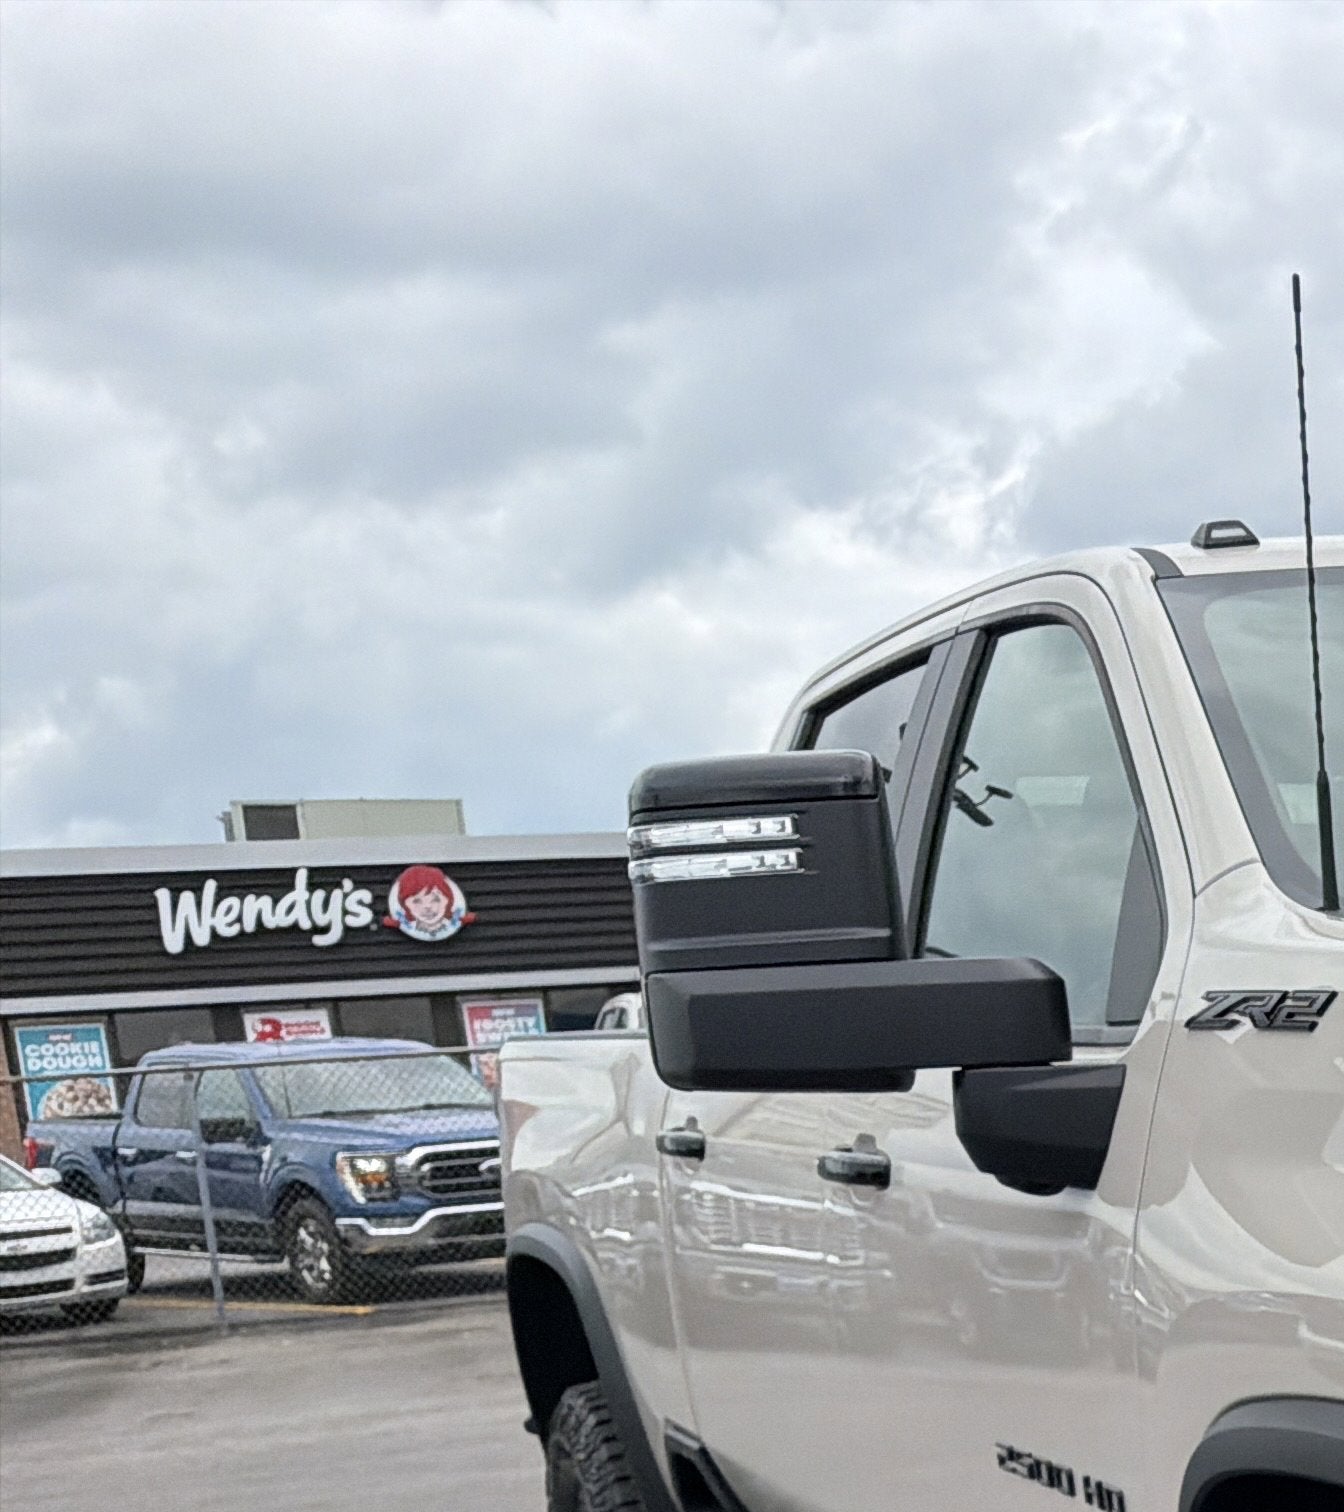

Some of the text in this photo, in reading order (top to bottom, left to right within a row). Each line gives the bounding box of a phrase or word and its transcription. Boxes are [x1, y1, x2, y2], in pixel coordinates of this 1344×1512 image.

[153, 868, 373, 954] Wendy's
[1184, 989, 1339, 1032] ZR2
[25, 1041, 99, 1057] COOKIE
[27, 1055, 103, 1071] DOUGH
[995, 1442, 1077, 1498] 2500
